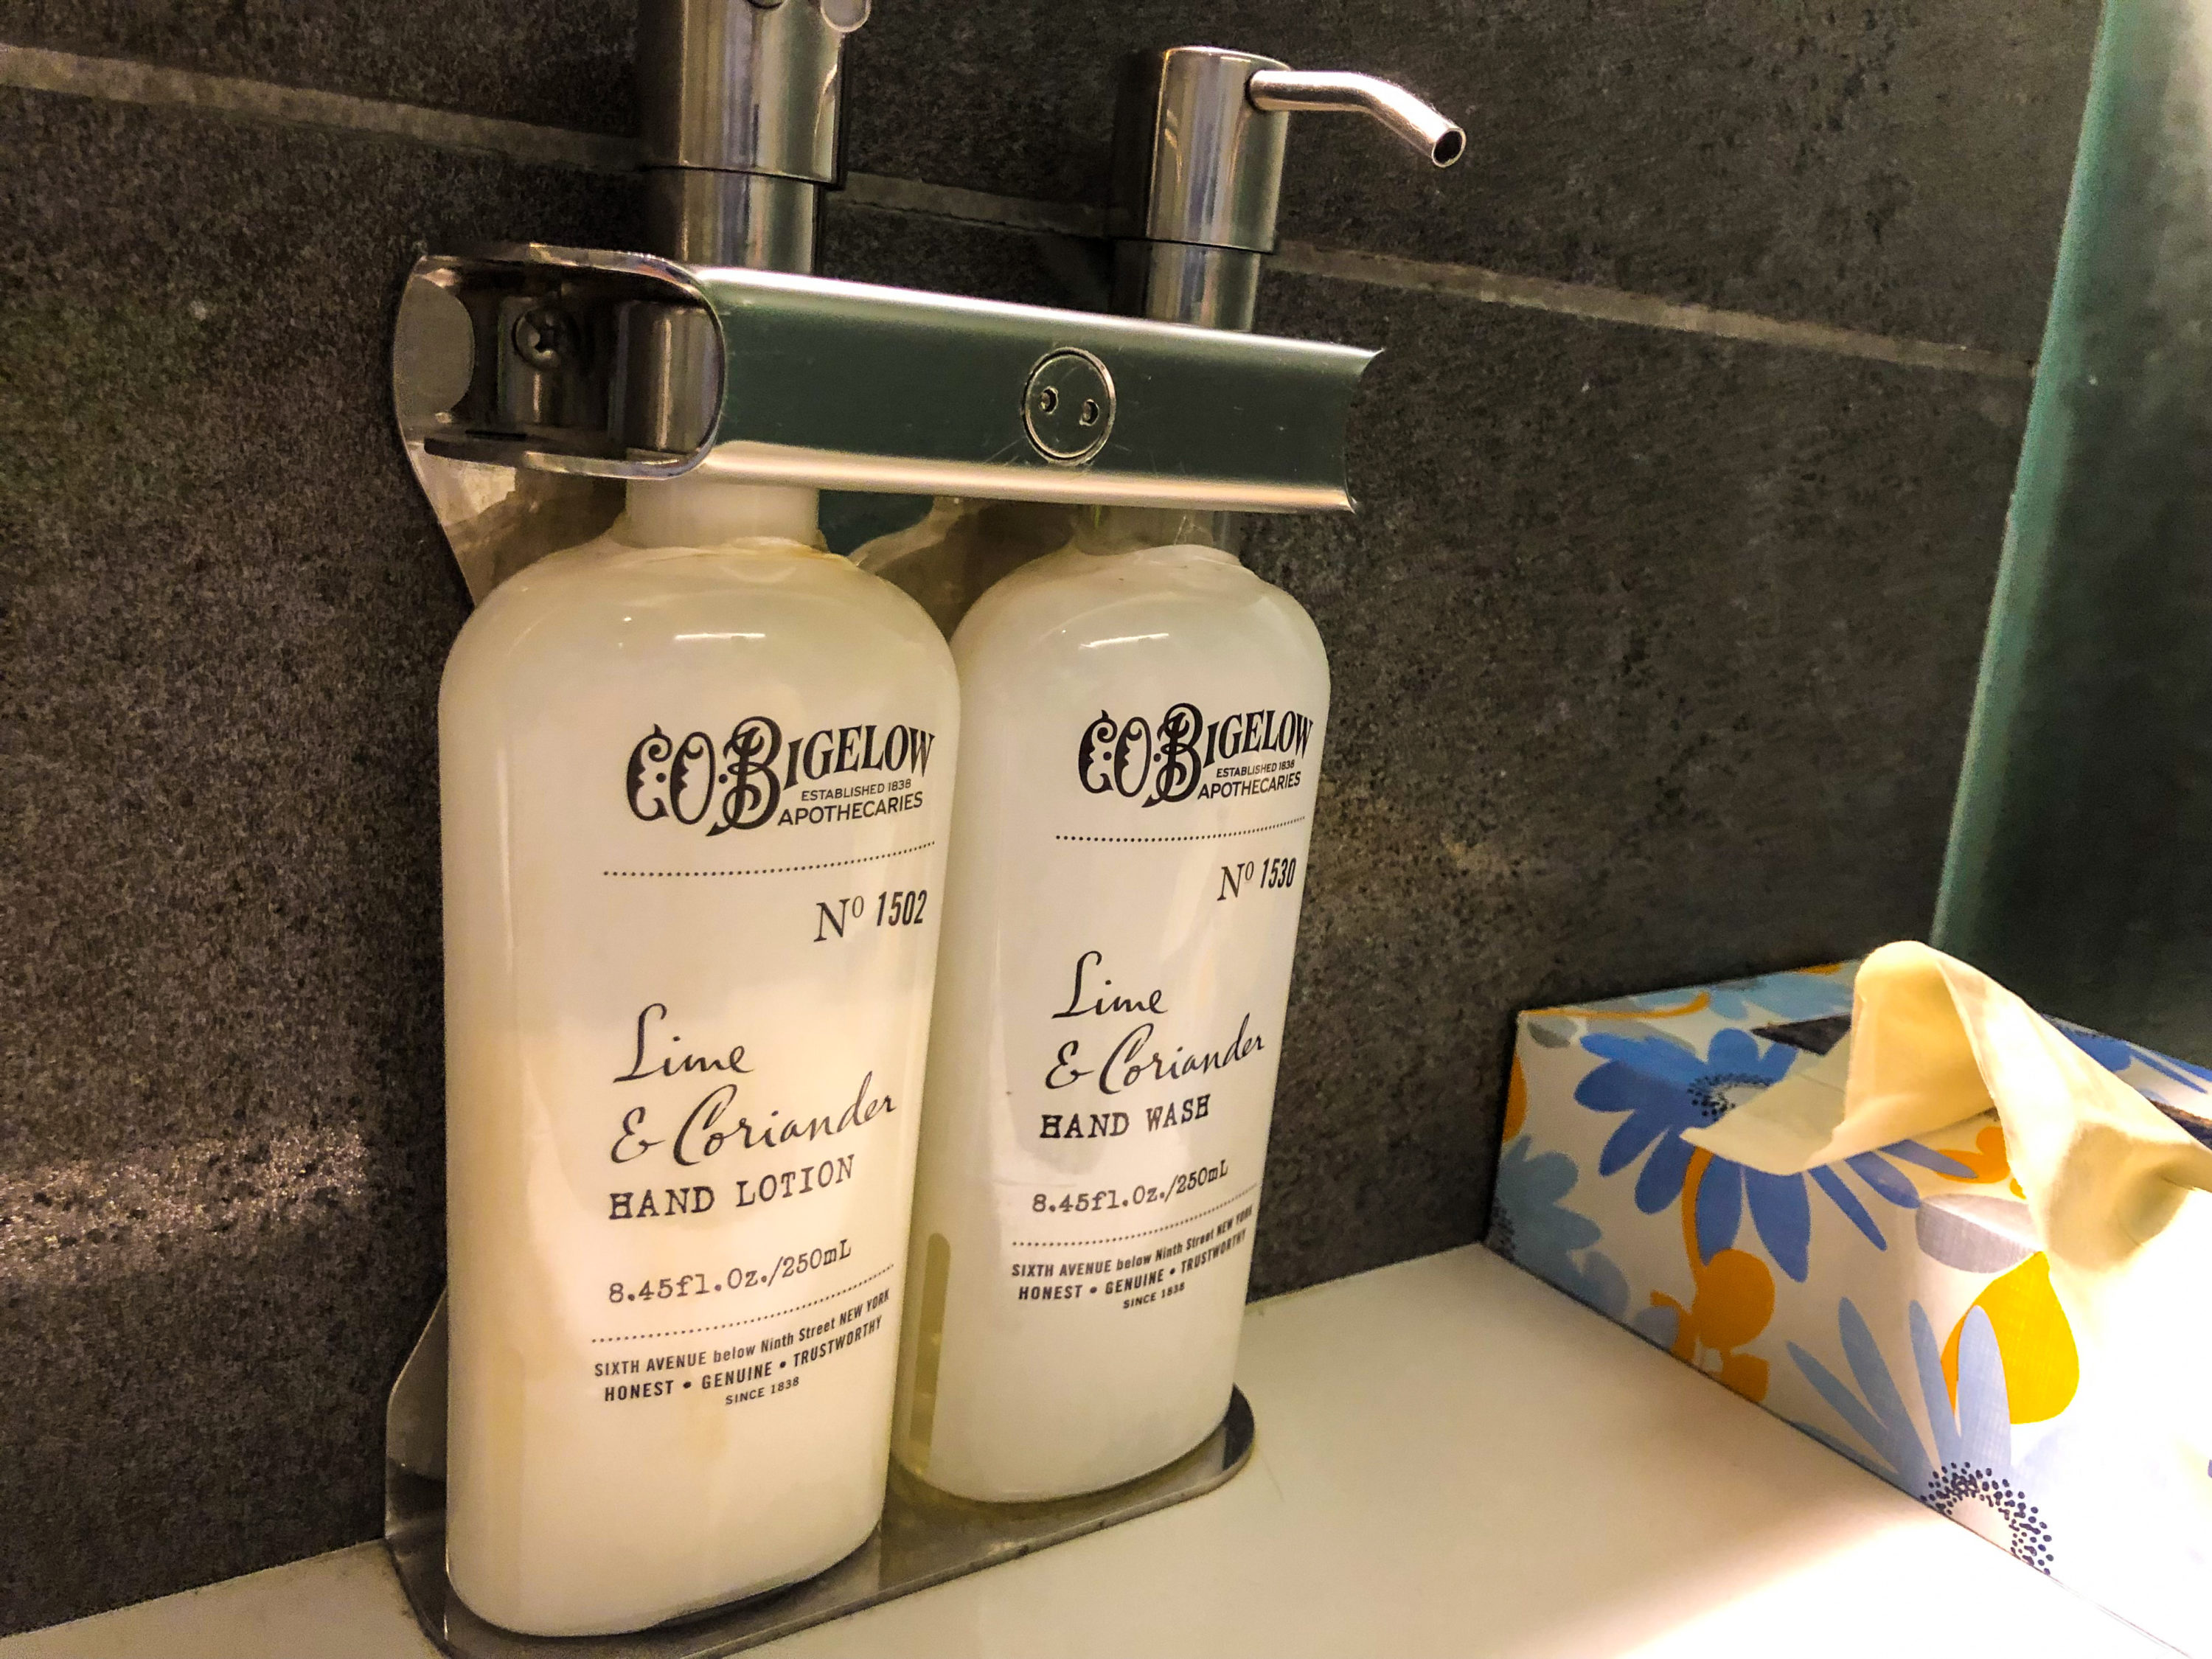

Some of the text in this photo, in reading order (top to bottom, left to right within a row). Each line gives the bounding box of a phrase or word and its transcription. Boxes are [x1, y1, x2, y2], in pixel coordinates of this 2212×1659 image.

[801, 778, 911, 801] ESTABLISHED 1838
[1197, 771, 1301, 799] APOTHECARIES
[1217, 763, 1276, 778] ESTABLISHED
[778, 791, 923, 826] APOTHECARIES
[1260, 858, 1296, 888] 1530
[876, 889, 928, 926] 1502
[1051, 950, 1168, 1019] Lime
[613, 1003, 754, 1083] Lime
[1045, 1013, 1265, 1094] & Coriander
[611, 1071, 897, 1166] & Coriander
[1040, 1094, 1211, 1138] HAND WASH
[608, 1154, 855, 1220] HAND LOTION
[1012, 1204, 1253, 1277] SIXTH AVENUE below Ninth Street NEW YORK
[1018, 1229, 1247, 1301] HONEST GENUINE TRUSTWORTHY
[1123, 1292, 1157, 1310] SINCE
[594, 1288, 890, 1377] SIXTH AVENUE below Ninth Street NEW YORK
[604, 1315, 883, 1402] HONEST GENUINE TRUSTWORTHY
[725, 1376, 800, 1405] SINCE 1838
